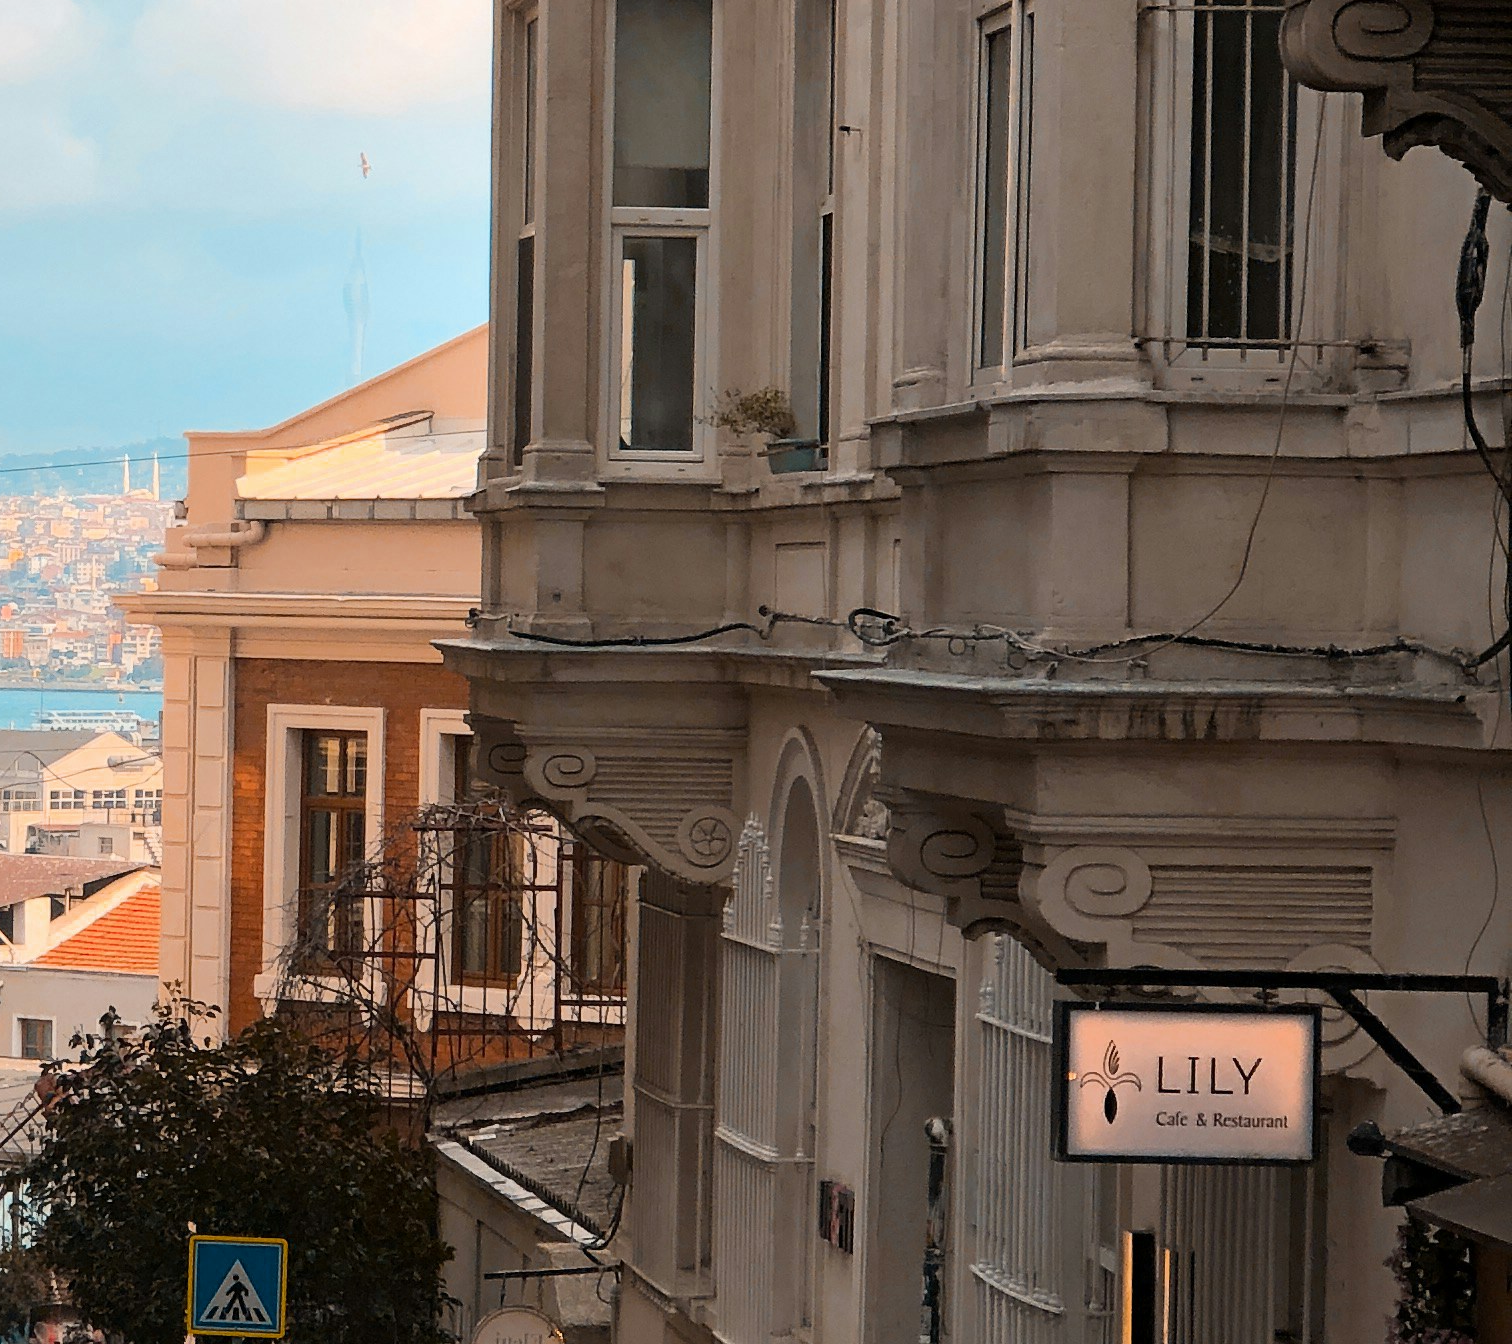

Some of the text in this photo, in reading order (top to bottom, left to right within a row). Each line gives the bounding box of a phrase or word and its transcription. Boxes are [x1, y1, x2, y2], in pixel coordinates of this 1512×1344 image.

[1158, 1056, 1263, 1095] LILY
[1156, 1111, 1288, 1129] Cafe & Restaurant
